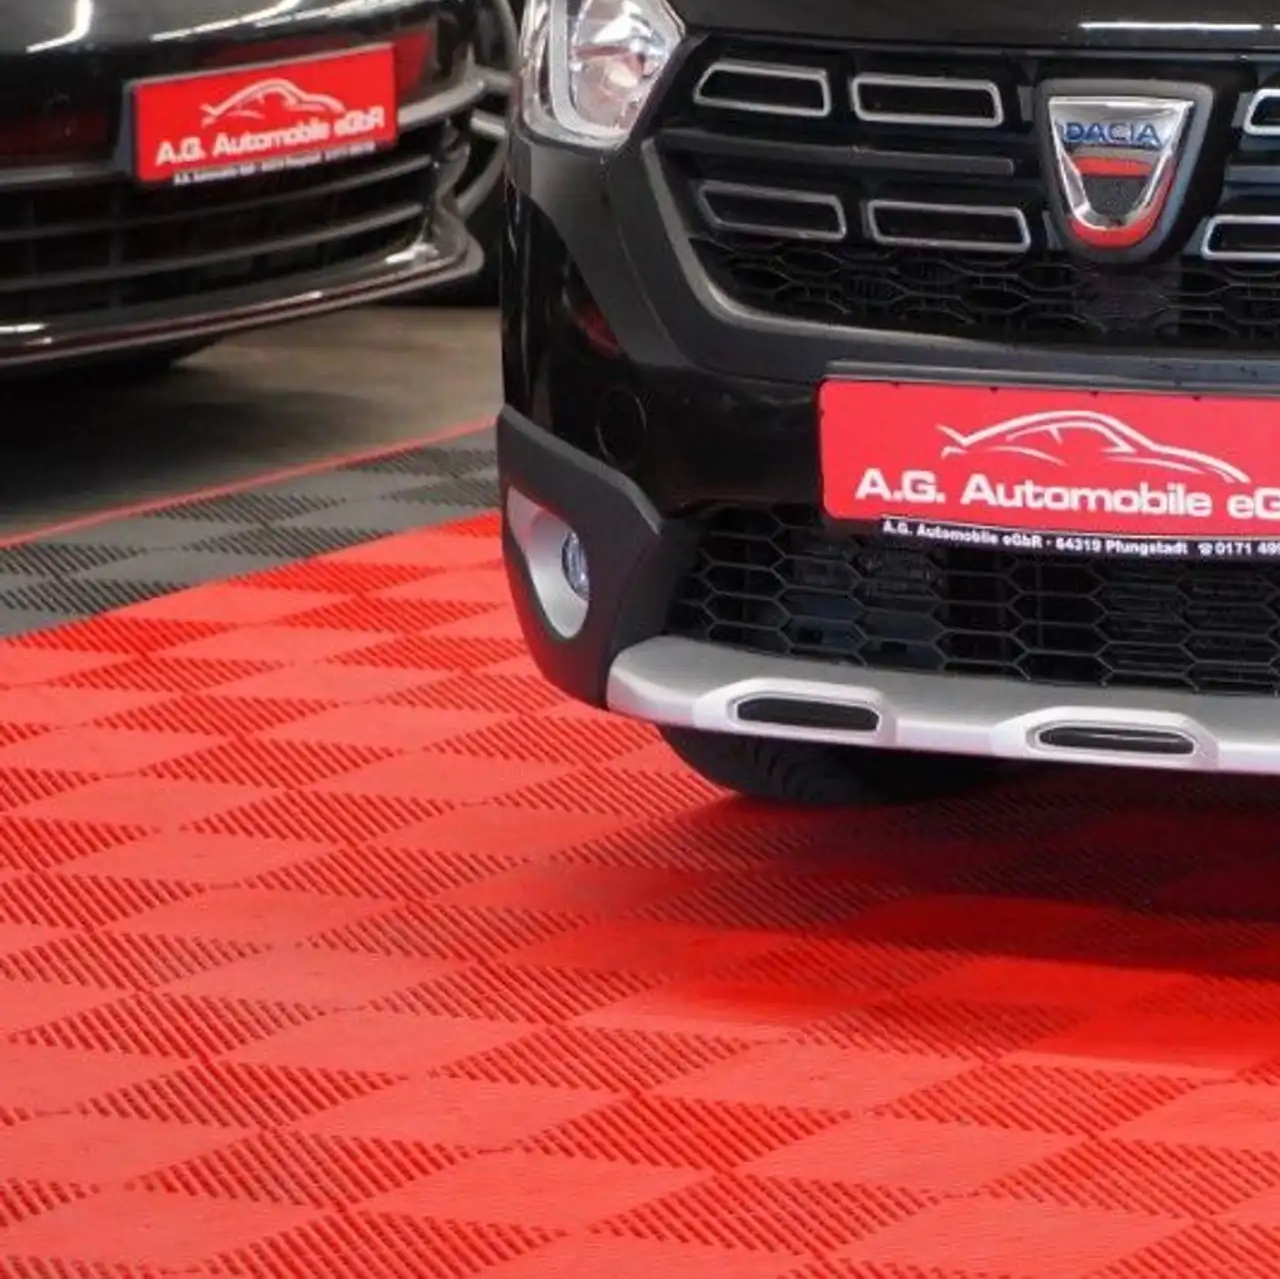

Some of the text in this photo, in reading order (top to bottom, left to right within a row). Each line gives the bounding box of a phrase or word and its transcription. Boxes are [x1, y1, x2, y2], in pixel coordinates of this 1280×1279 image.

[155, 137, 205, 166] A.G.
[213, 117, 330, 156] Automobile
[1065, 121, 1160, 143] DACIA
[855, 468, 946, 503] A.G.
[961, 473, 1214, 518] Automobile
[883, 519, 912, 535] A.G.
[916, 524, 999, 546] Automobile
[1002, 532, 1043, 549] eGbR
[1055, 537, 1101, 553] 64319
[1105, 539, 1189, 557] Pfungstadt
